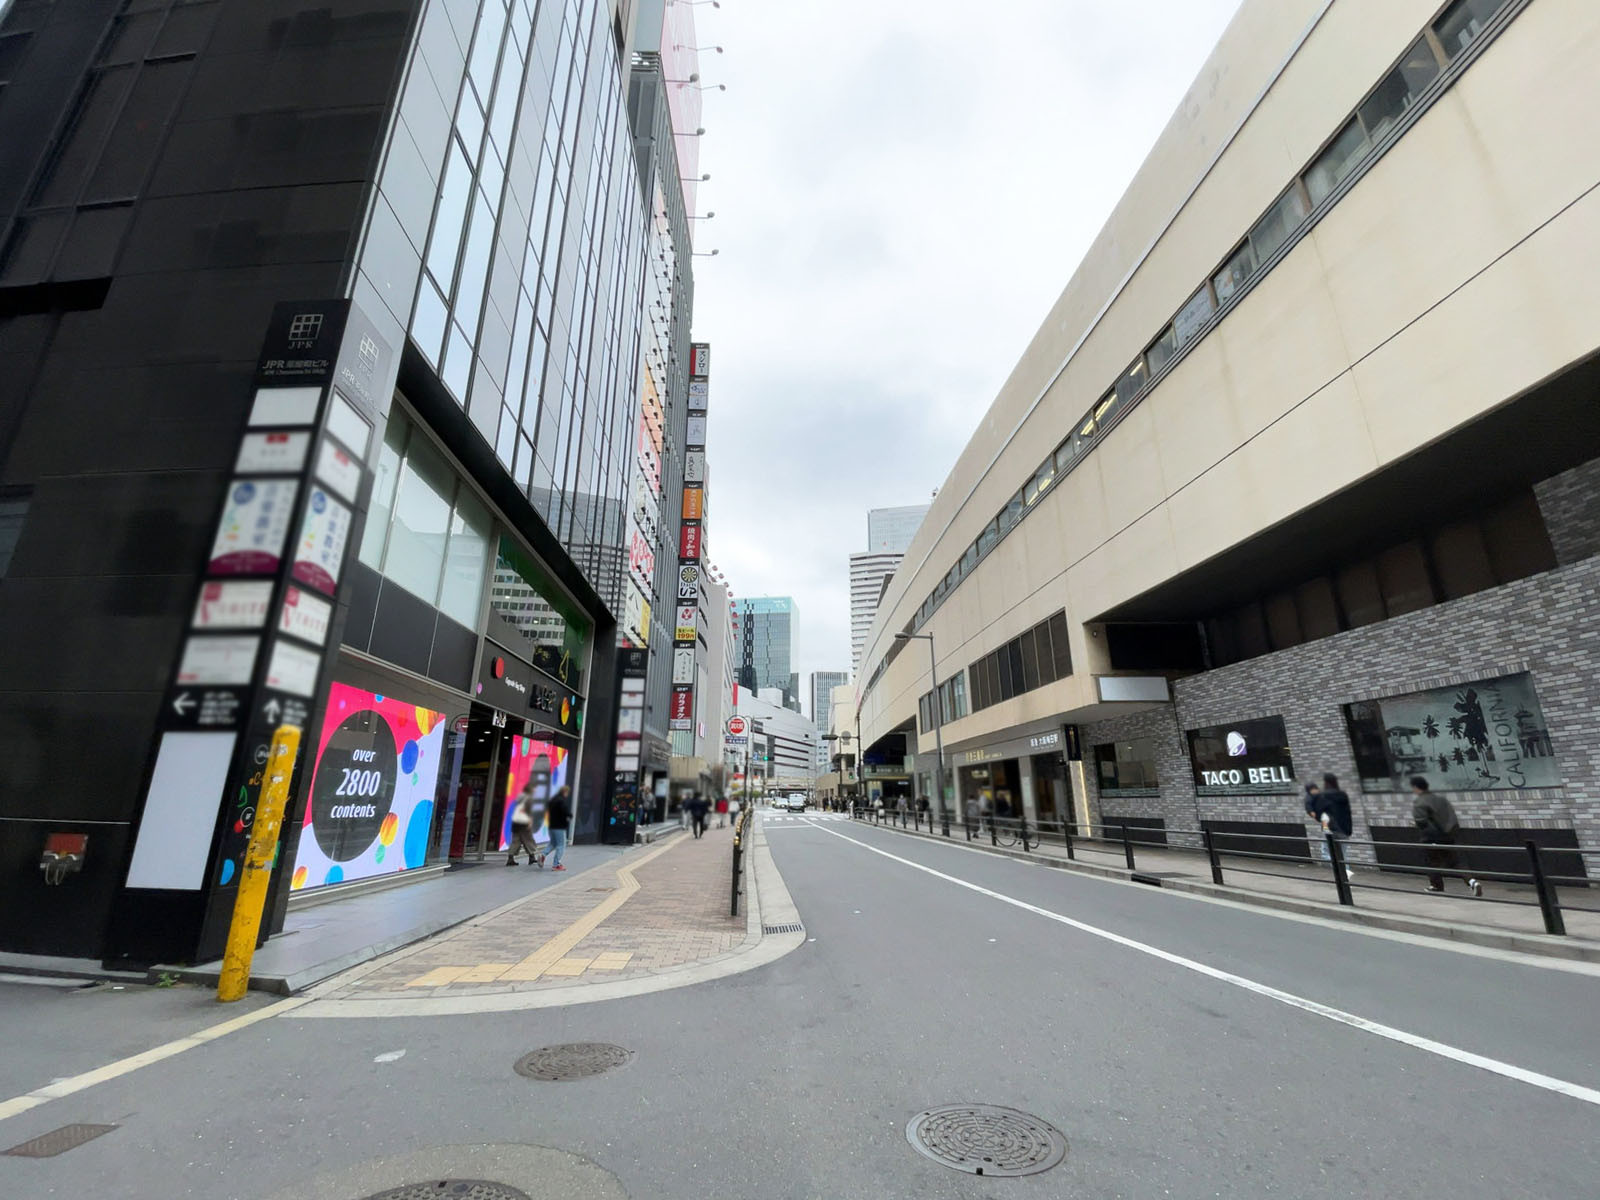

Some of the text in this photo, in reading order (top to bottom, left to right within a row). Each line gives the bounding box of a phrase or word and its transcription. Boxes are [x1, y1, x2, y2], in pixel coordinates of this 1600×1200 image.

[288, 341, 313, 350] JPR
[262, 360, 285, 369] JPR
[341, 367, 356, 385] JPR
[679, 586, 697, 598] UP
[677, 692, 686, 720] カラオケ
[352, 748, 377, 763] over
[335, 767, 381, 797] 2800
[1201, 766, 1291, 786] TACO BELL
[330, 803, 377, 819] contents
